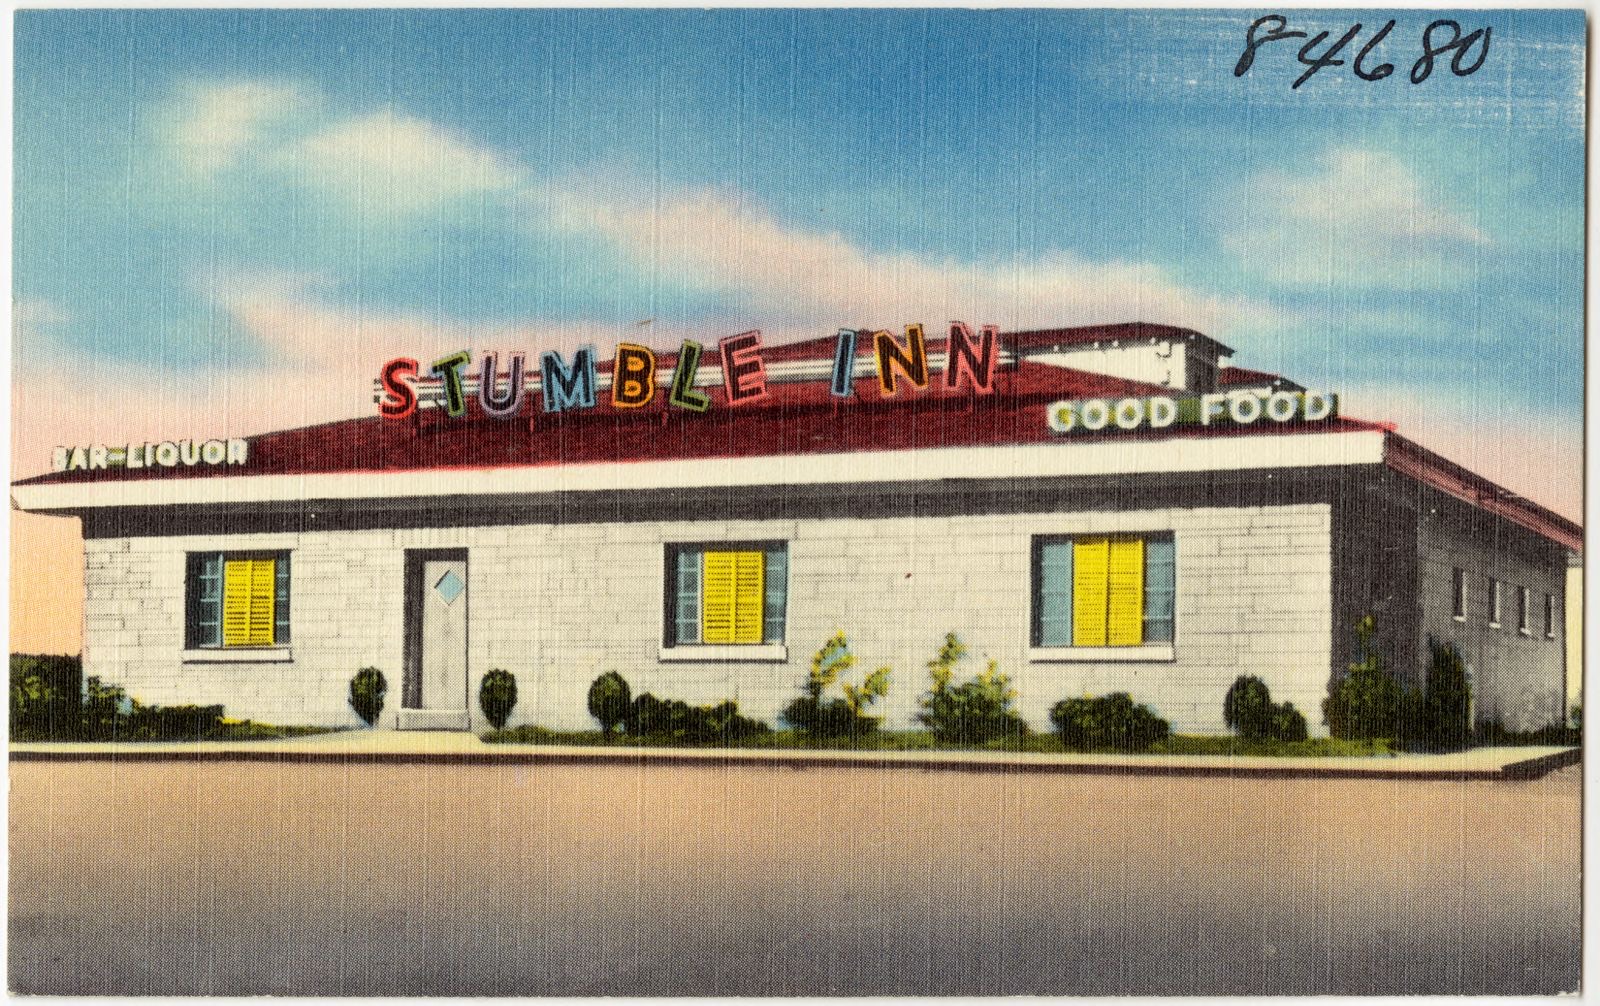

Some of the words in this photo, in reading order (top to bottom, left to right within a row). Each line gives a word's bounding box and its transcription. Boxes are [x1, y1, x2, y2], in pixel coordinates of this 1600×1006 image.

[1234, 15, 1493, 89] 84680
[378, 329, 768, 420] STUMBLE
[831, 321, 1000, 399] INN
[1047, 396, 1177, 433] GOOD
[1199, 390, 1338, 426] FOOD
